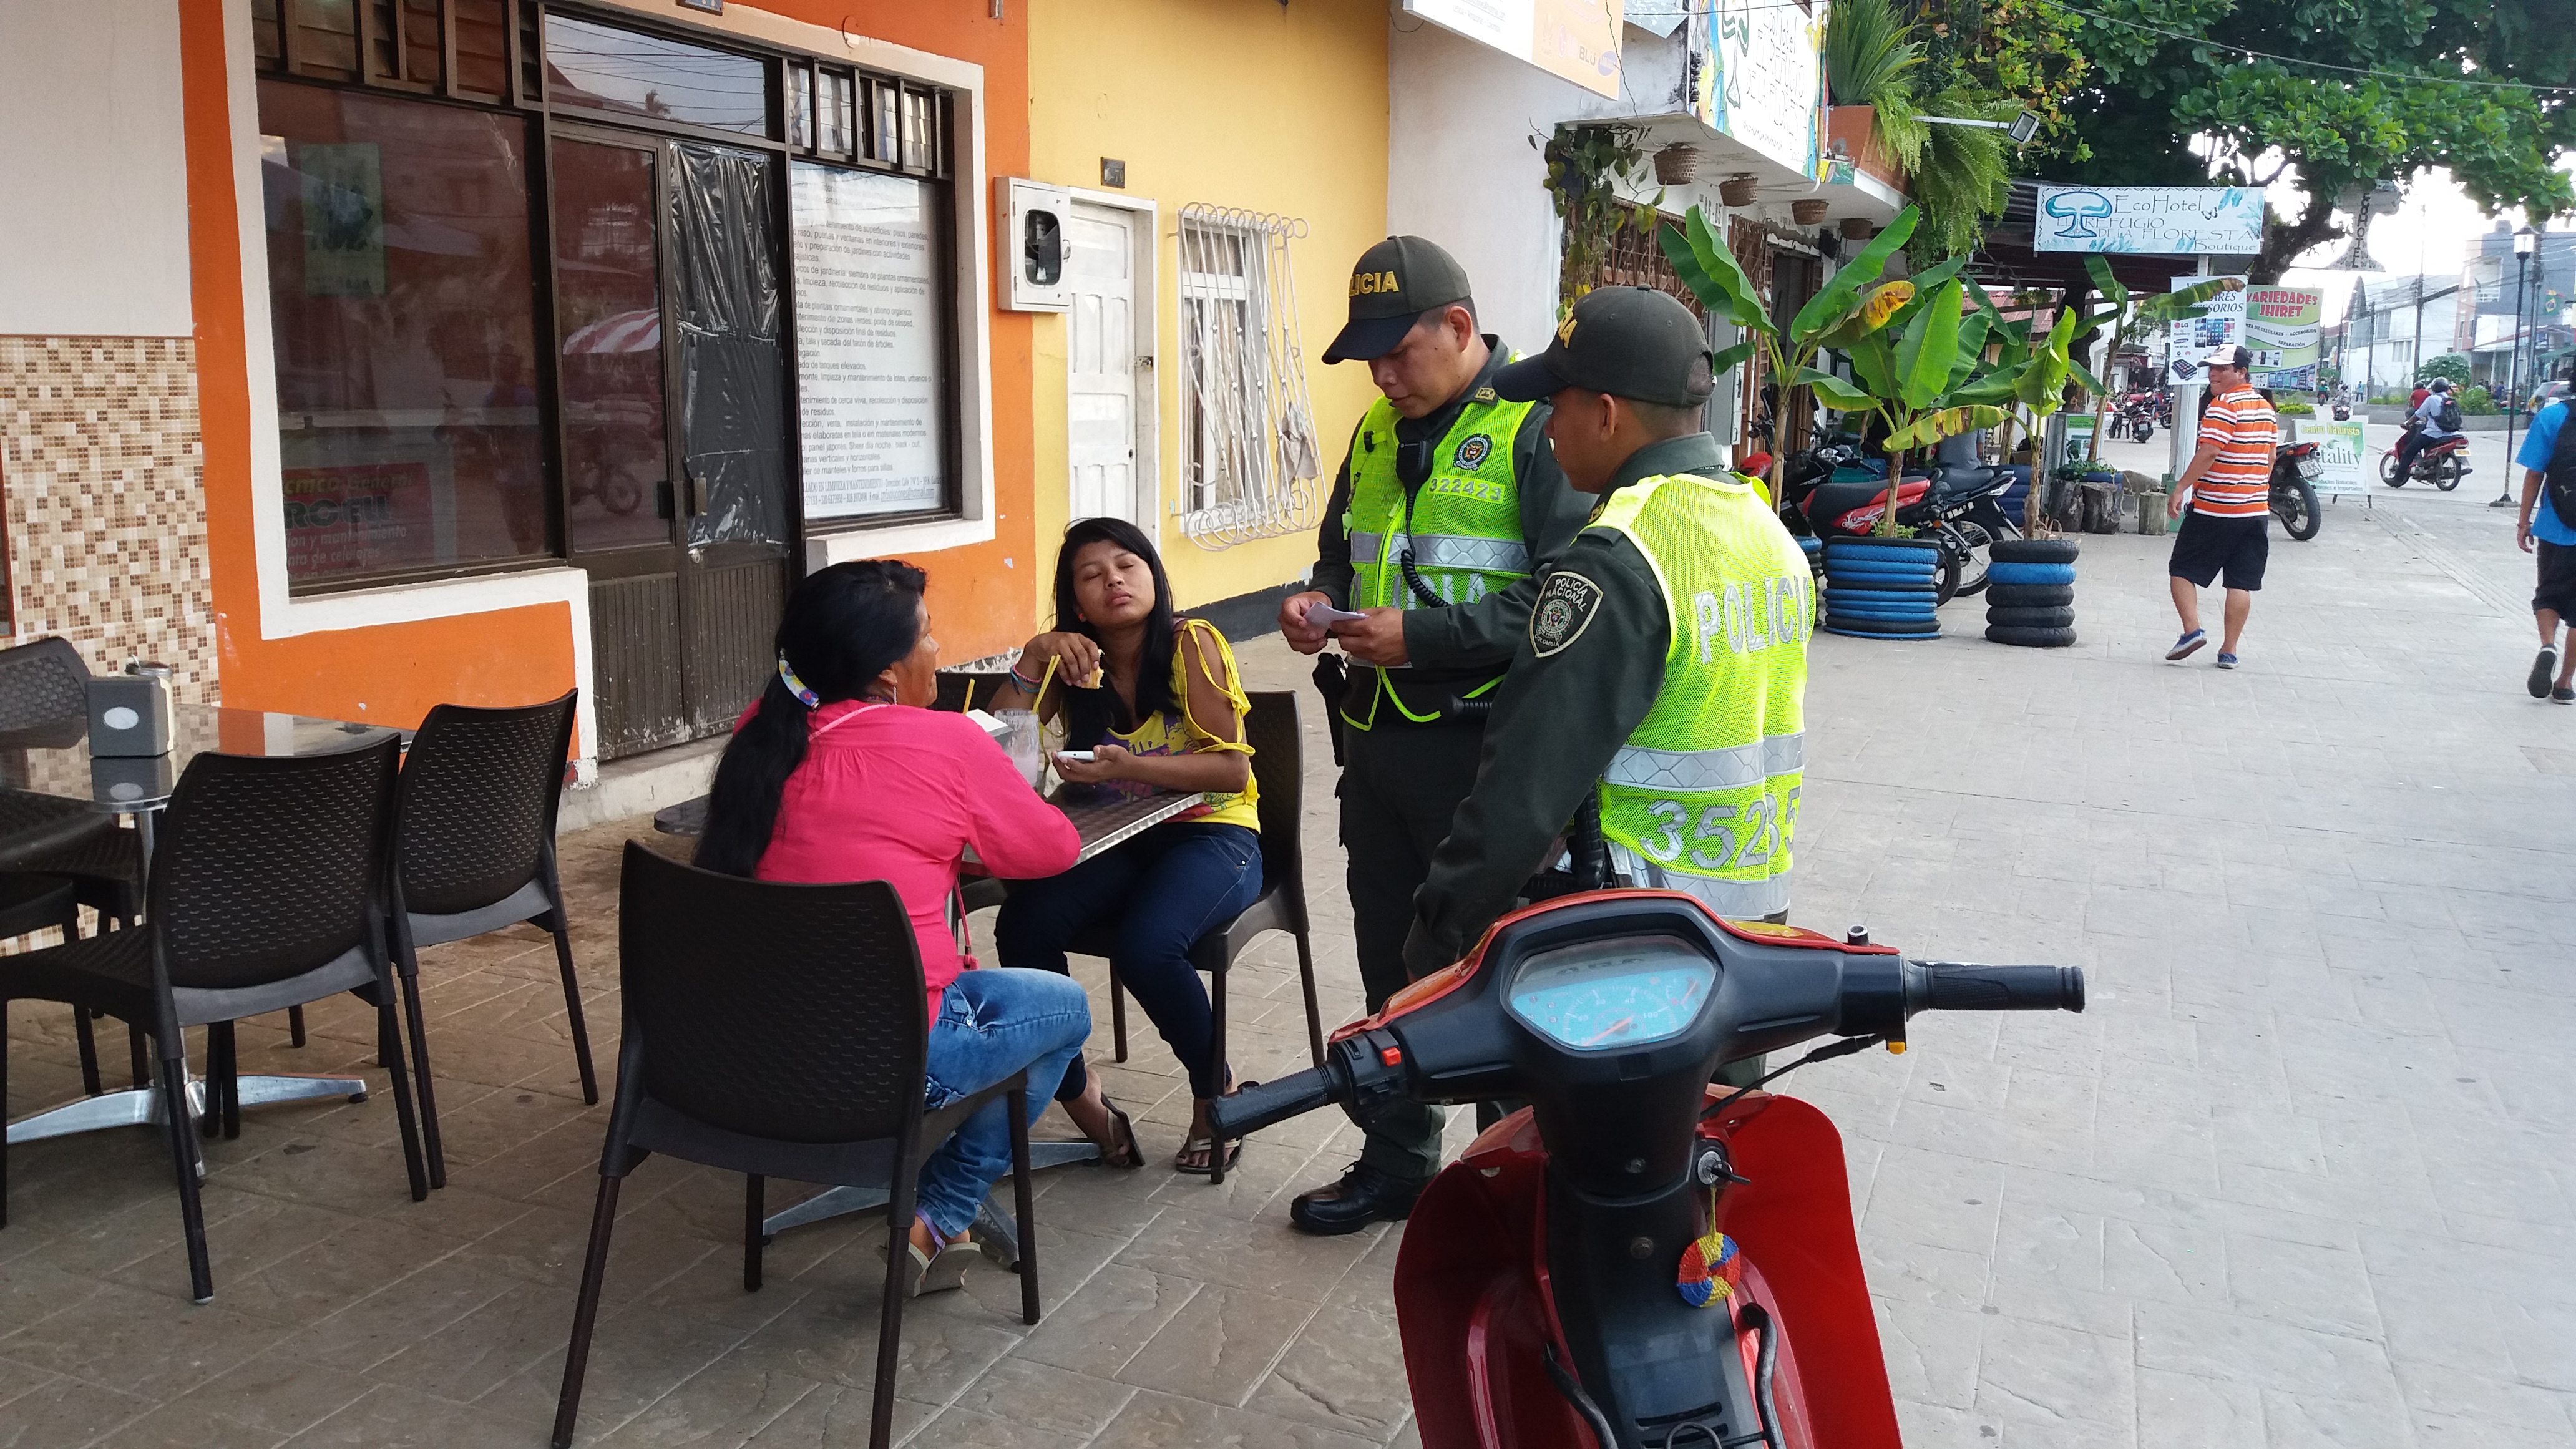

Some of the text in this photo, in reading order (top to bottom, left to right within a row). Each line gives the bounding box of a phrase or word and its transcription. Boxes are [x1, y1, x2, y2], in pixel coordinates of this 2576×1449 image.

[2114, 194, 2202, 214] EcoHotel
[2084, 217, 2164, 229] REFUGIO
[2142, 228, 2258, 242] FLORESTA
[2193, 240, 2256, 254] Boutique
[2247, 291, 2318, 306] VARIEDADES
[2258, 305, 2304, 318] JHIRET
[2301, 423, 2361, 436] Centro Naturista
[2320, 447, 2362, 471] tality
[1428, 477, 1502, 502] 322423
[310, 535, 316, 550] y
[320, 525, 407, 545] mantnimiento
[1545, 587, 1587, 613] NACIONAL
[1534, 632, 1560, 648] COLOMBIA
